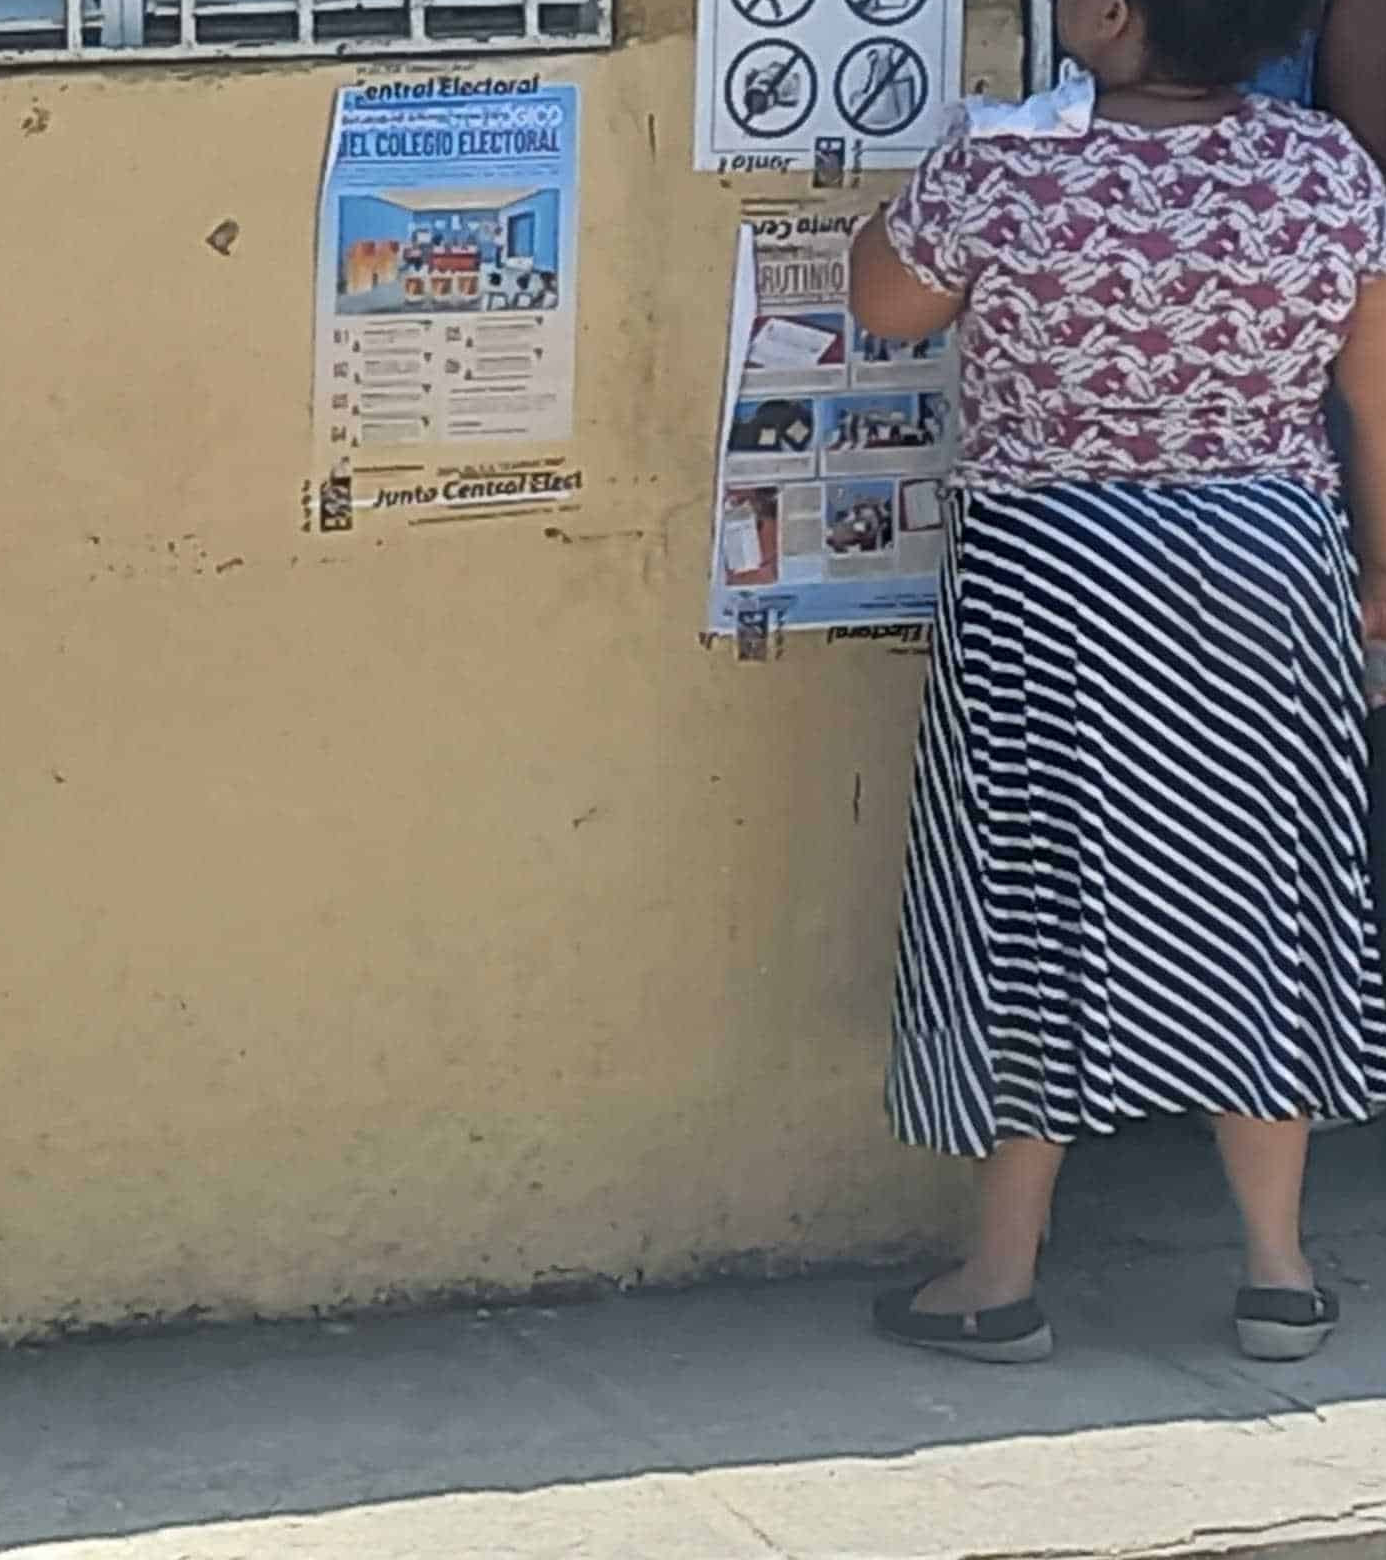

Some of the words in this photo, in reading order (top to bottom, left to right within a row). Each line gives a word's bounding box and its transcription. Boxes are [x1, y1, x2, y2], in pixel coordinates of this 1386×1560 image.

[437, 74, 540, 97] Electoral
[375, 129, 454, 157] COLEGIO
[458, 125, 561, 155] ELECTORAL
[373, 485, 438, 509] Junta
[442, 476, 527, 502] Central
